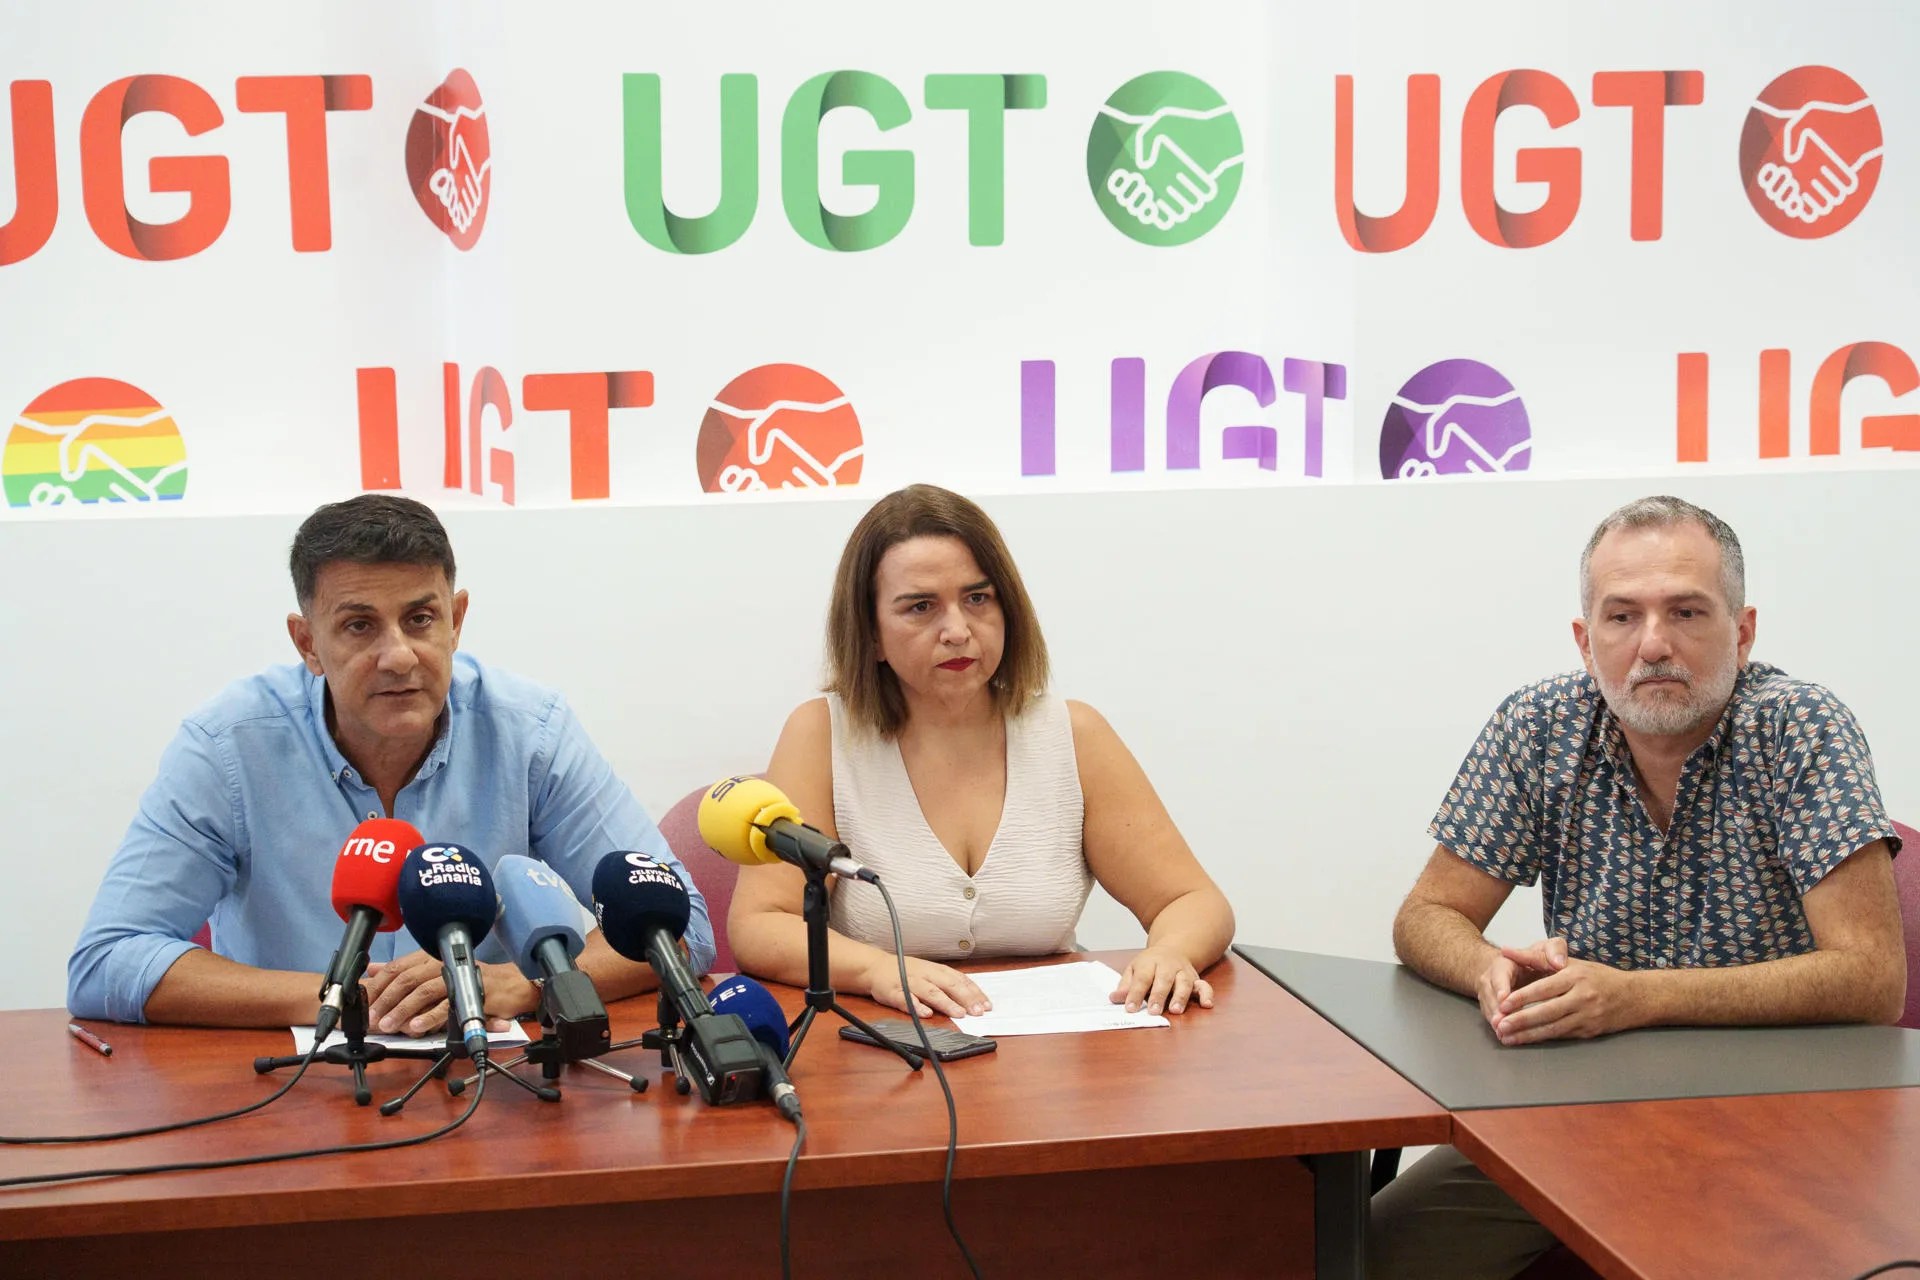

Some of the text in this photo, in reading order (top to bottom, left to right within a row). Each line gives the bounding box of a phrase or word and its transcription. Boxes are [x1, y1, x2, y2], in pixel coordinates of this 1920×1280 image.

[622, 69, 1048, 255] UGT
[1334, 68, 1705, 253] UGT
[343, 838, 395, 863] rne
[420, 872, 482, 887] Canaria
[432, 862, 480, 876] Radio
[628, 874, 684, 891] CANARIA
